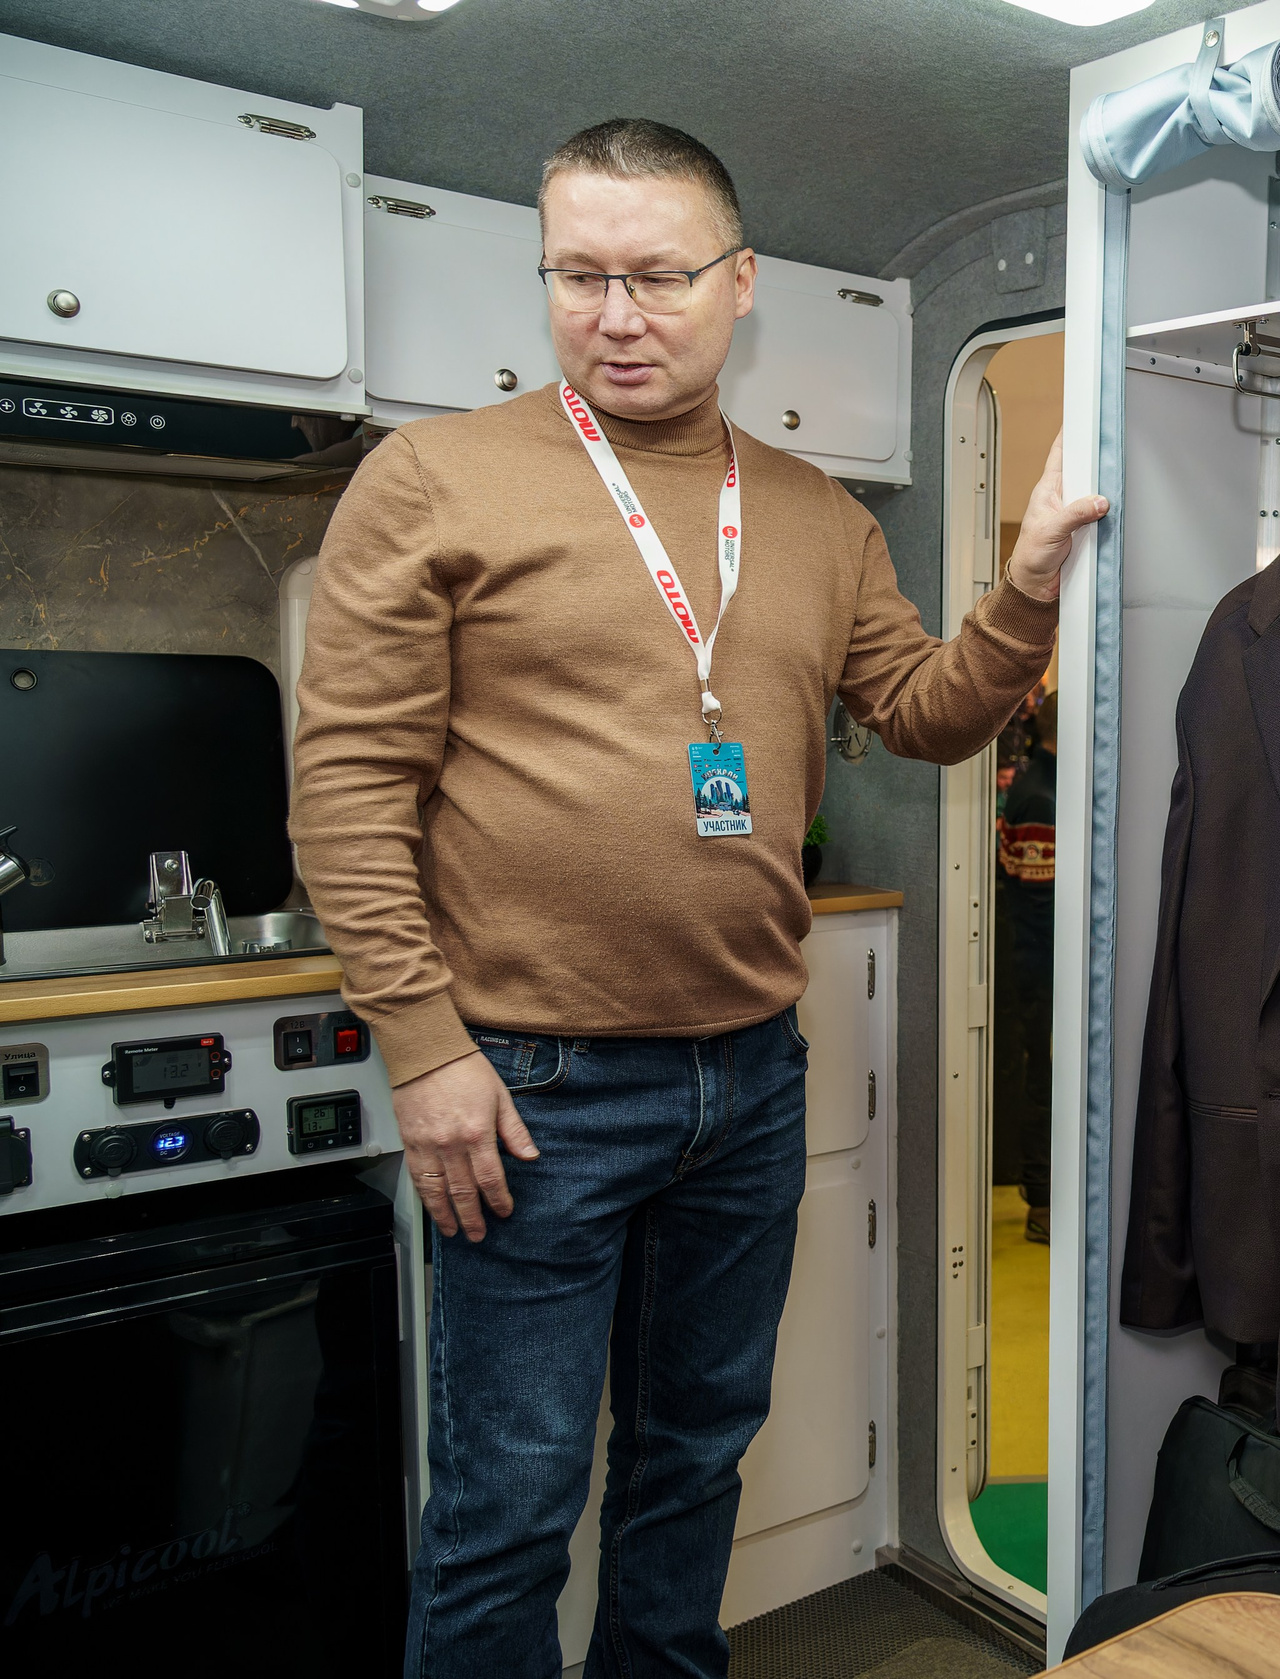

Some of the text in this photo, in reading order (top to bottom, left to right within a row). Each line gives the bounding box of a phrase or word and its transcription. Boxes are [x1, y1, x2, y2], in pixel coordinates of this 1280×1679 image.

[562, 385, 602, 442] MOTO
[613, 484, 633, 515] UNIVERSAL
[623, 490, 638, 513] MOTORS
[656, 569, 700, 644] MOTO
[703, 819, 747, 833] УЧАСТНИК
[4, 1052, 36, 1061] Улица
[2, 1503, 240, 1628] Alpicool
